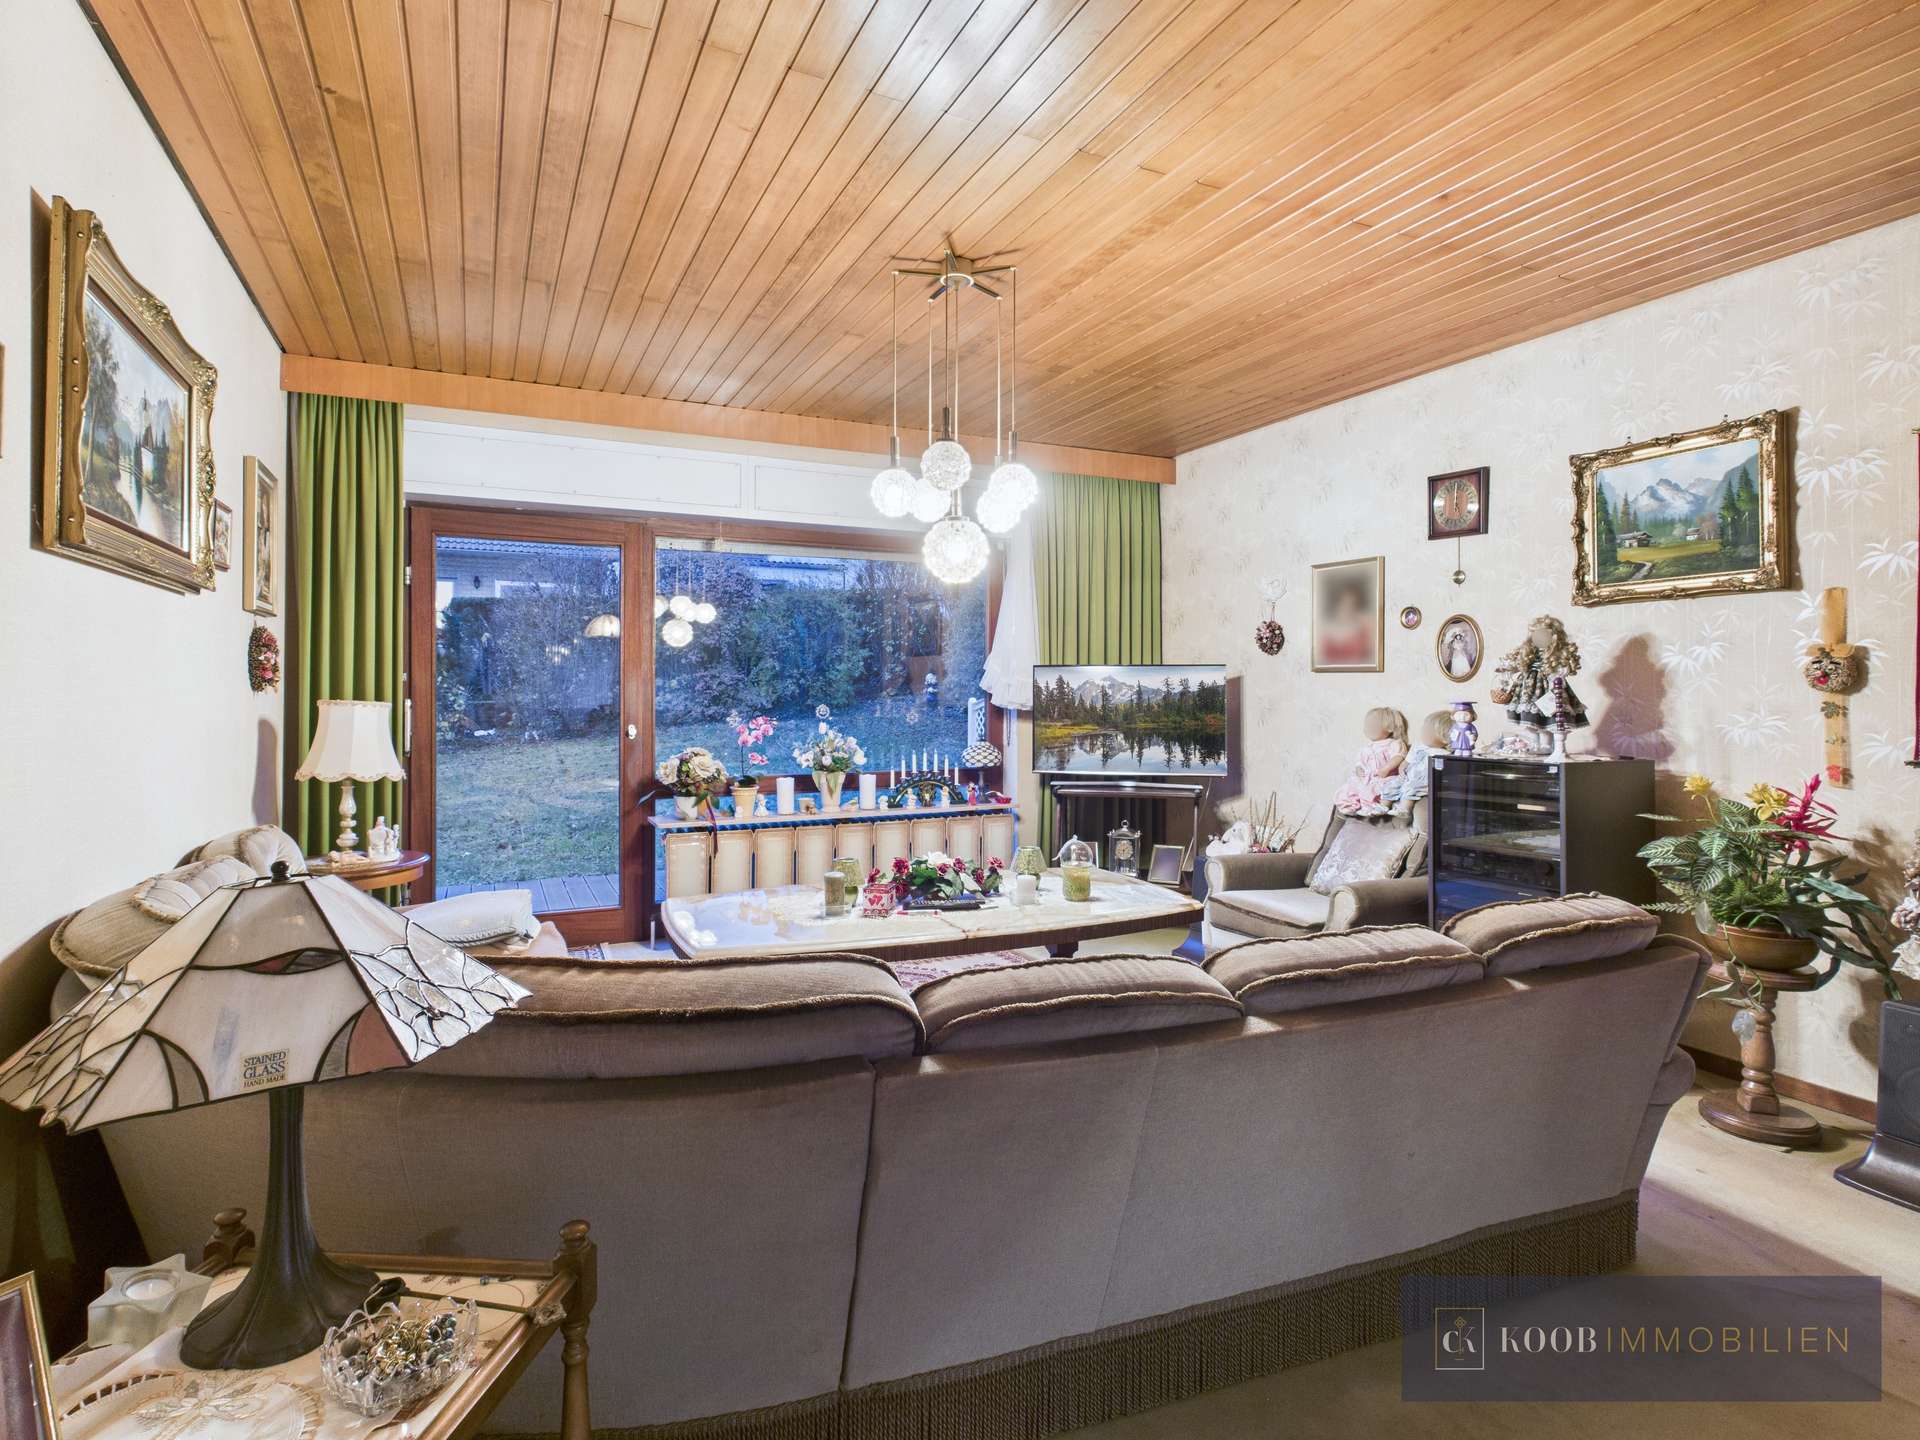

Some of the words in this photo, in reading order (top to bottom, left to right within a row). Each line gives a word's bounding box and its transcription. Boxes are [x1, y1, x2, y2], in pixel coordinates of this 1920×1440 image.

[243, 1051, 286, 1067] STAINED
[243, 1061, 285, 1079] GLASS
[243, 1079, 265, 1088] HAND
